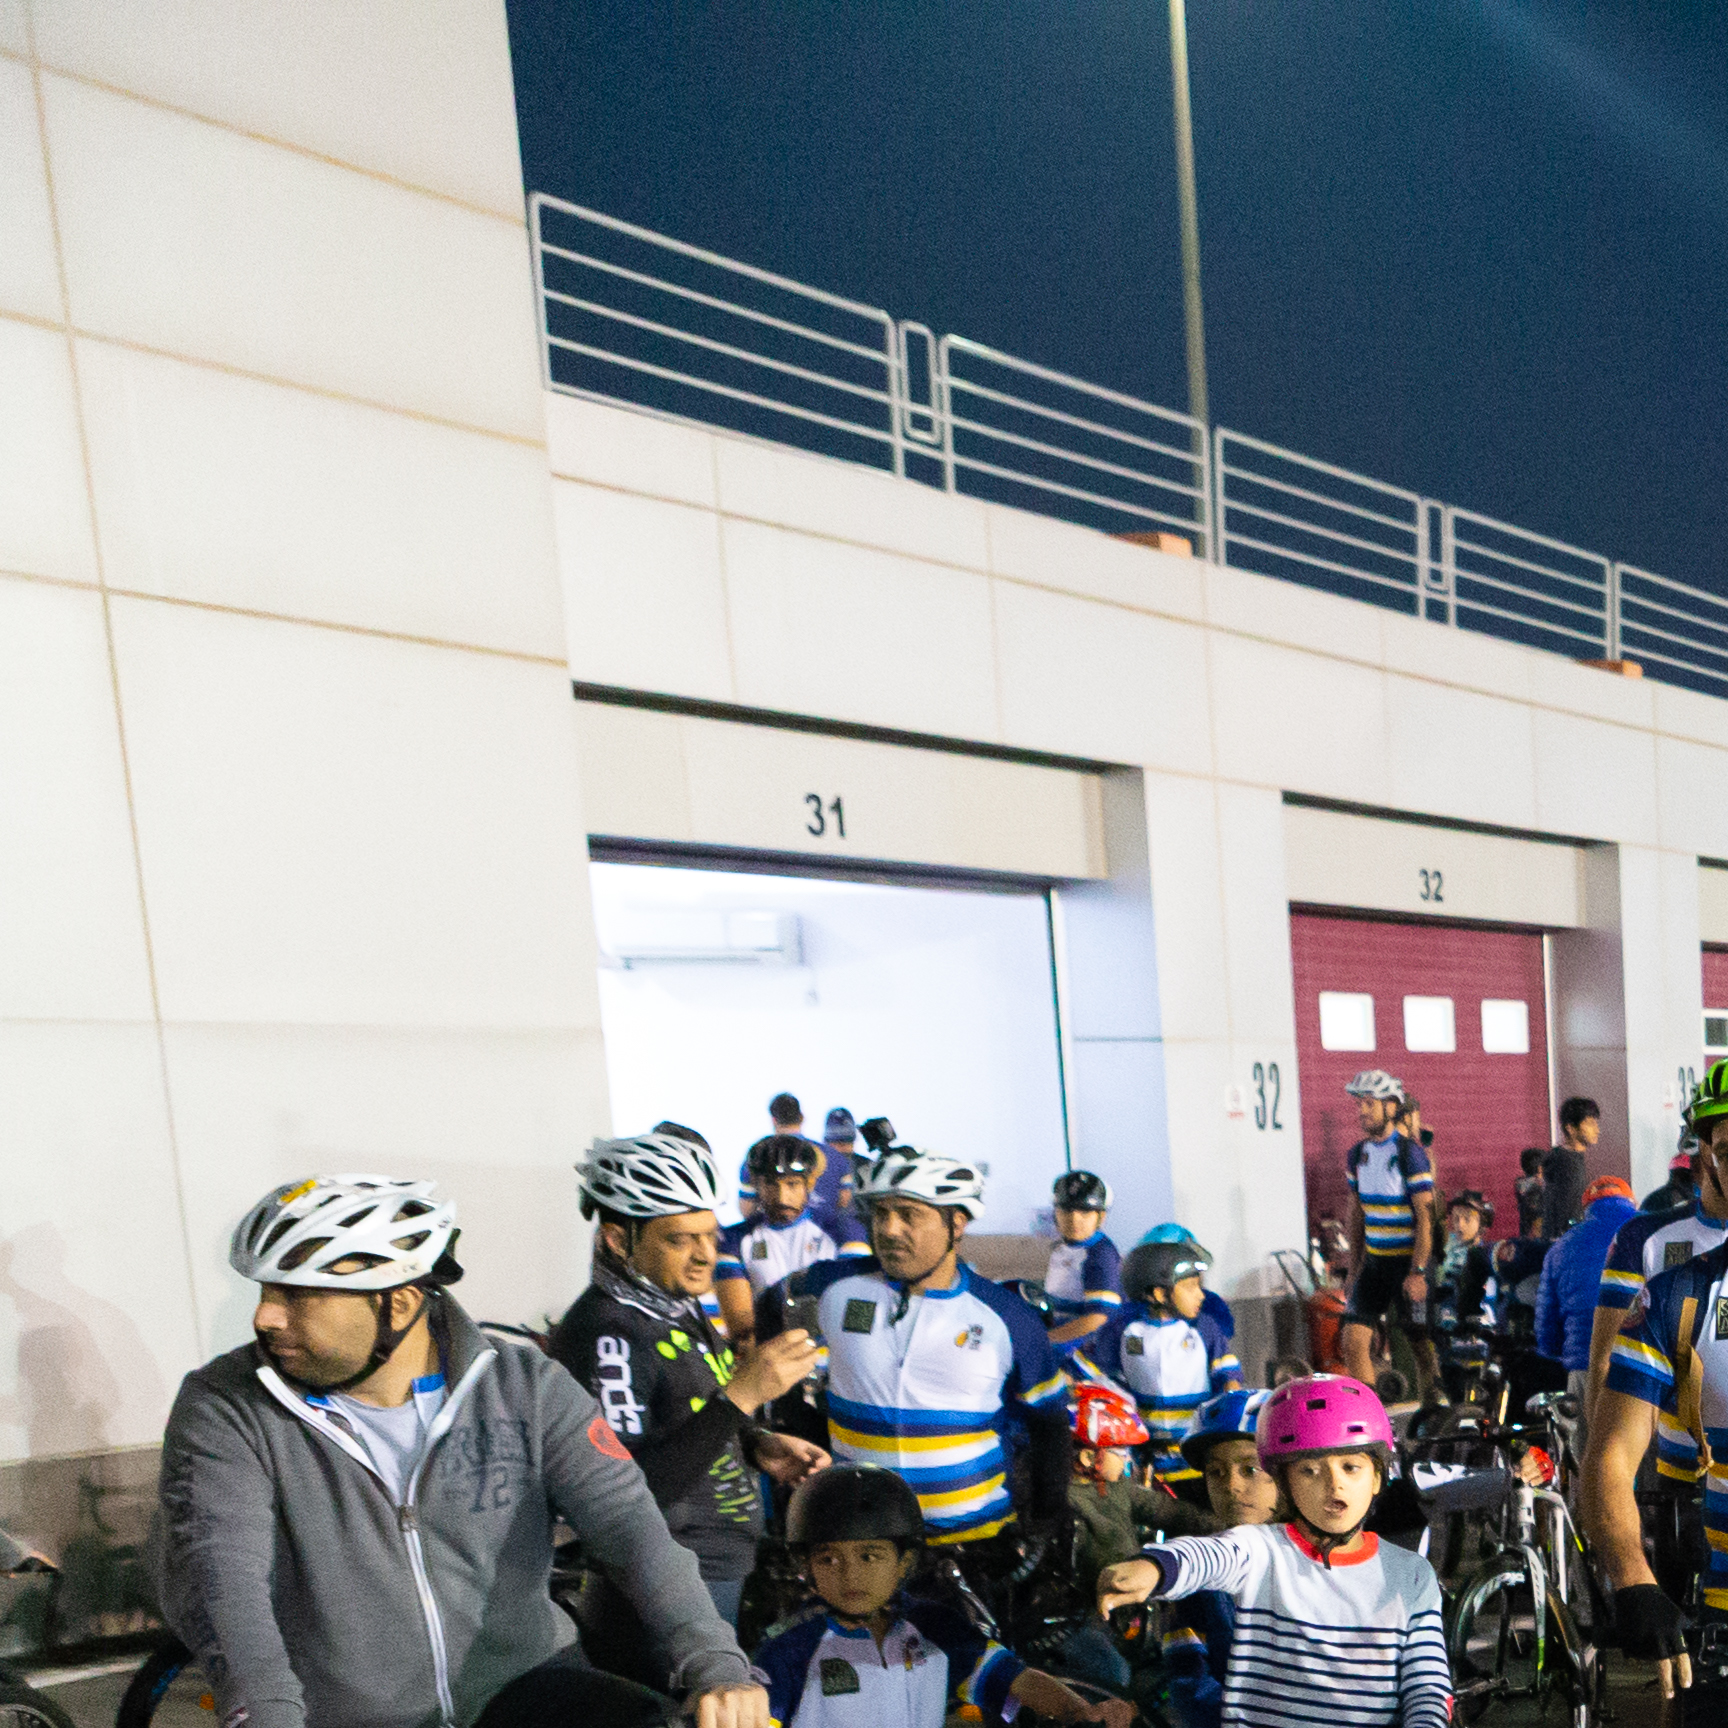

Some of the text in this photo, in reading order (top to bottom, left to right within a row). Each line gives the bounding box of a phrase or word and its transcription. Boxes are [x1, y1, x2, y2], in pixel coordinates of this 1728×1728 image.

[803, 792, 846, 839] 31
[1418, 868, 1444, 902] 32
[1253, 1062, 1283, 1131] 32
